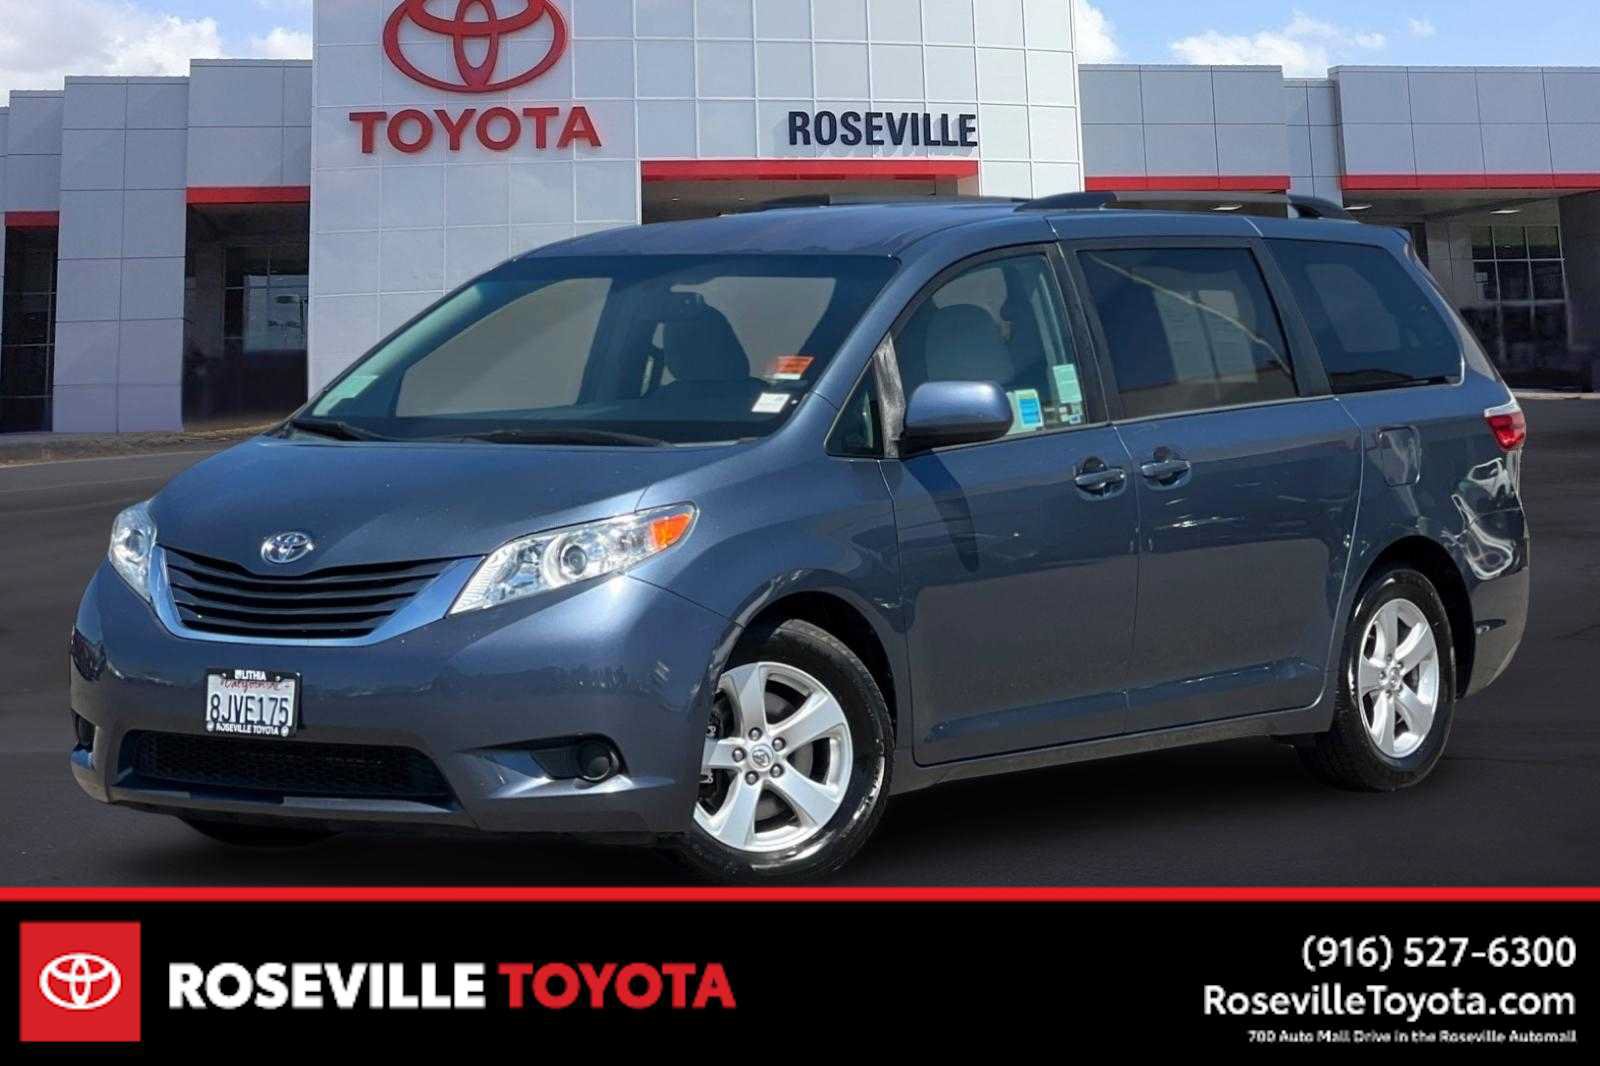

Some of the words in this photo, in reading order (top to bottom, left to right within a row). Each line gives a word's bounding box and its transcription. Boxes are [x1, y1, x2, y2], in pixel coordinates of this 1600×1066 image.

[349, 105, 602, 153] TOYOTA
[789, 110, 978, 148] ROSEVILLE
[210, 694, 289, 727] 8JVE175
[216, 722, 252, 734] ROSEVILLE
[253, 724, 279, 735] TOYOTA
